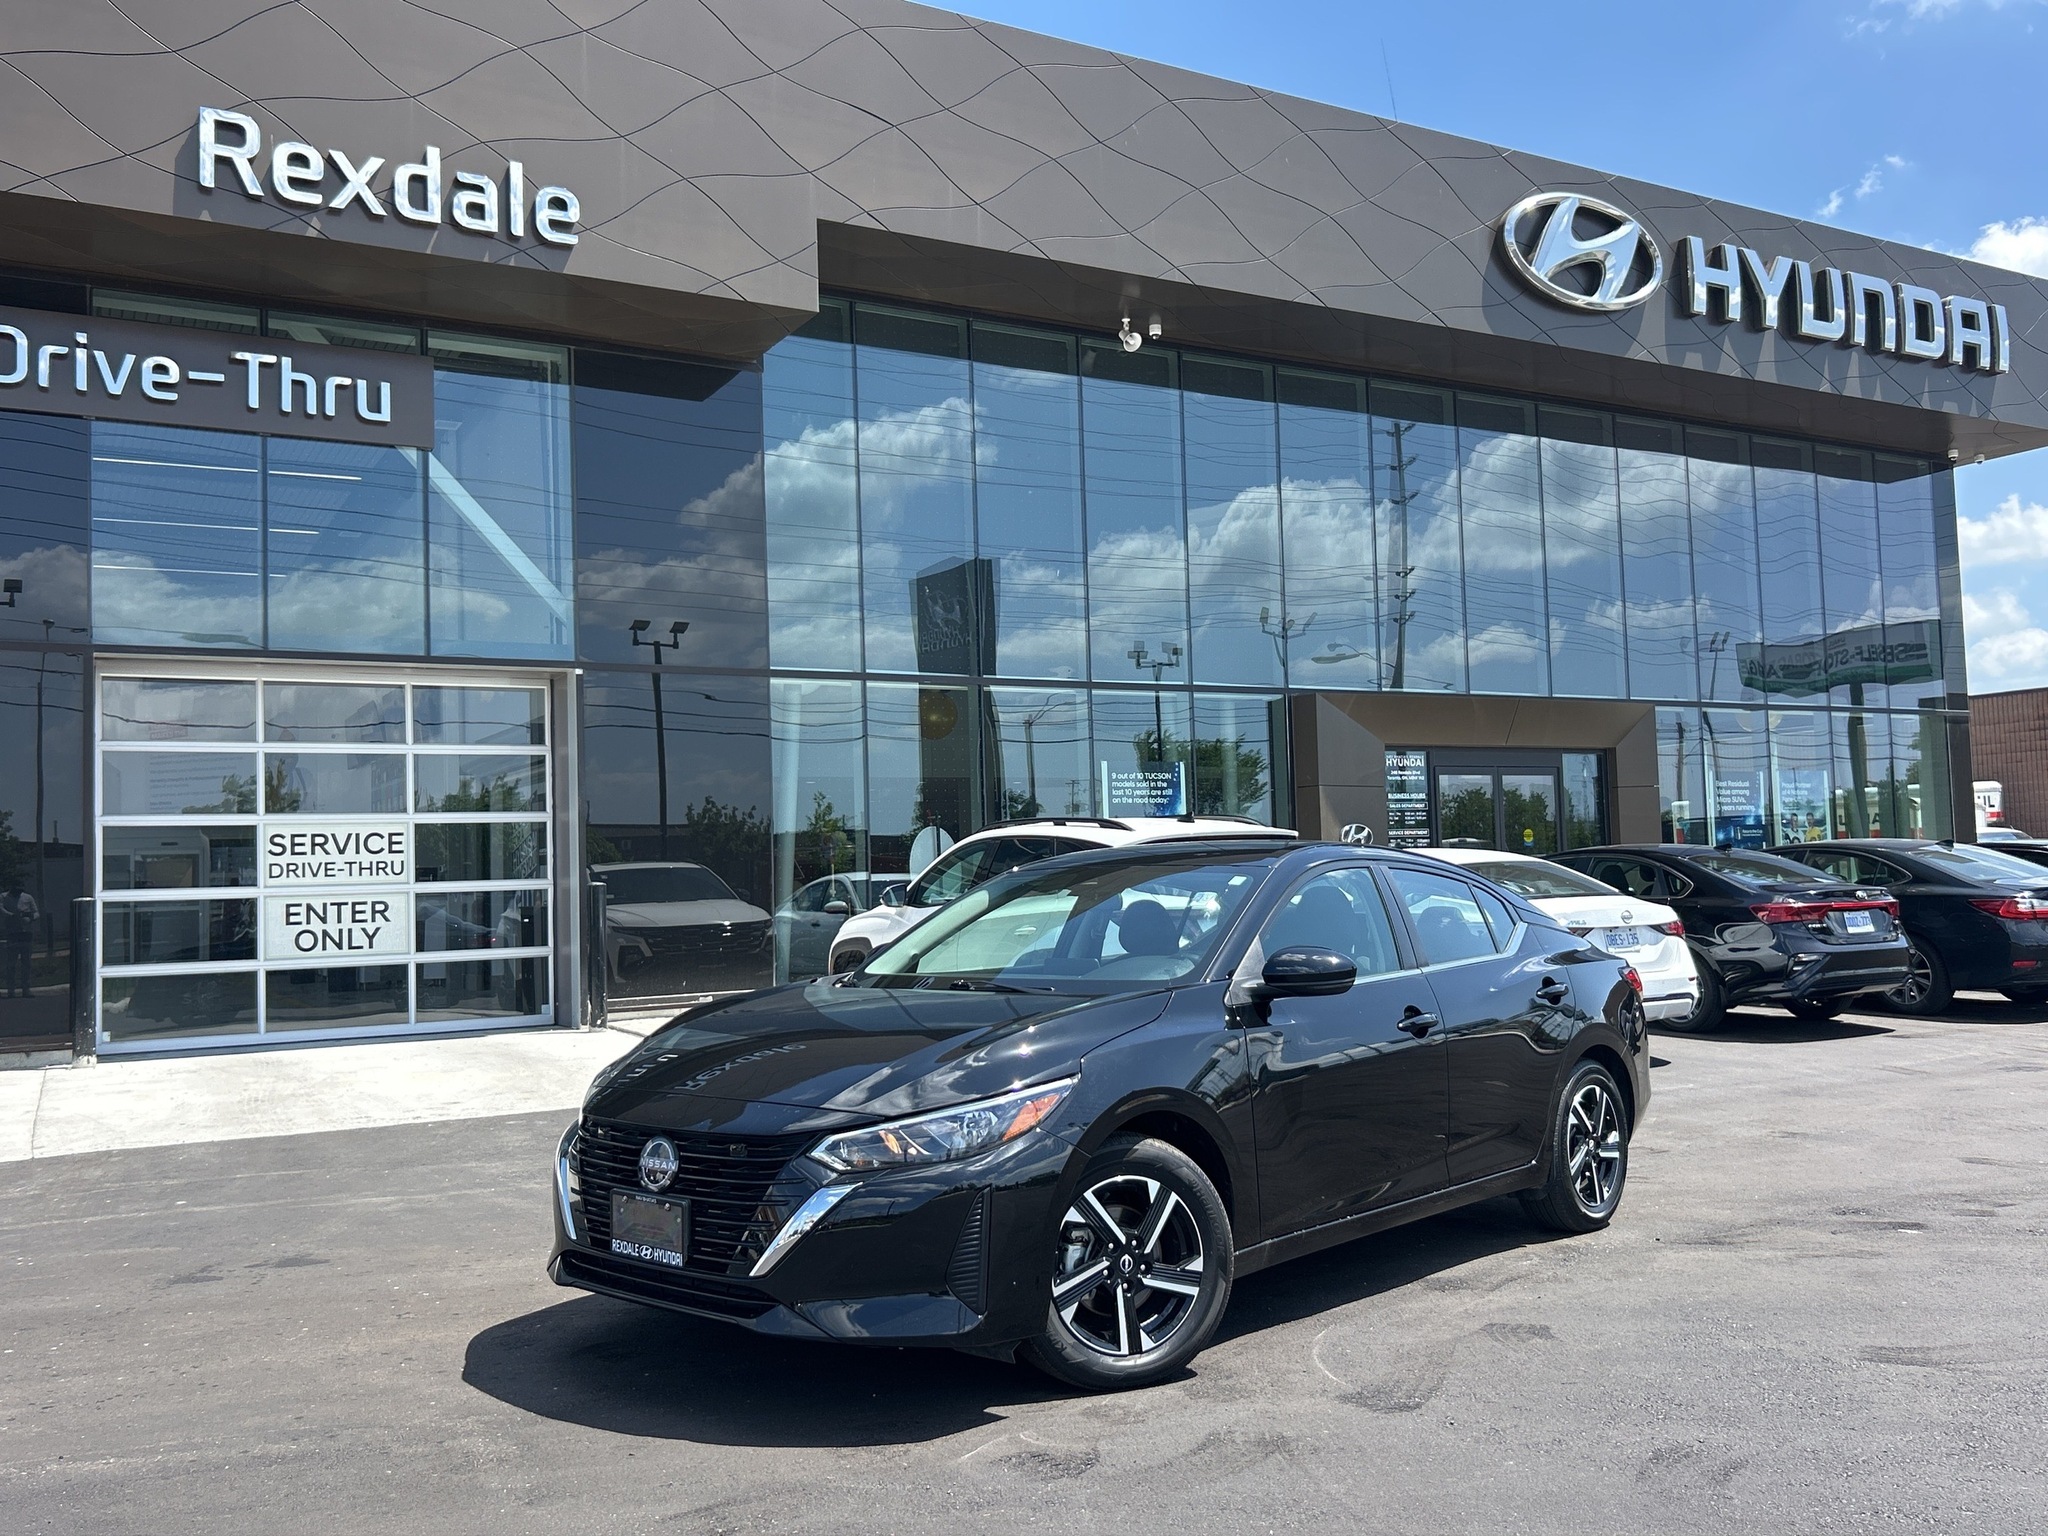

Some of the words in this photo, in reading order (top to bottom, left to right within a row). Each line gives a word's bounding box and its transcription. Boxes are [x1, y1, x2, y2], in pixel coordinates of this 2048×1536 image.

[199, 105, 581, 246] Rexdale
[1681, 235, 2010, 374] HYUNDAI
[1385, 758, 1425, 767] HYUNDAI
[1111, 772, 1117, 780] 9
[1117, 772, 1128, 780] out
[1128, 772, 1136, 780] of
[1136, 772, 1144, 780] 10
[1144, 772, 1172, 780] TUCSON
[1111, 780, 1136, 788] models
[1136, 780, 1150, 788] sold
[1157, 780, 1167, 788] the
[1112, 788, 1124, 796] last
[1125, 788, 1132, 796] 10
[1133, 789, 1150, 797] years
[1162, 788, 1173, 796] still
[1731, 789, 1750, 797] among
[267, 832, 405, 857] SERVICE
[268, 860, 405, 879] DRIVE-THRU
[285, 900, 392, 926] ENTER
[294, 926, 382, 953] ONLY
[640, 1157, 678, 1171] NISSAN
[611, 1238, 640, 1257] REXDALE
[652, 1246, 684, 1267] HYUNDAI
